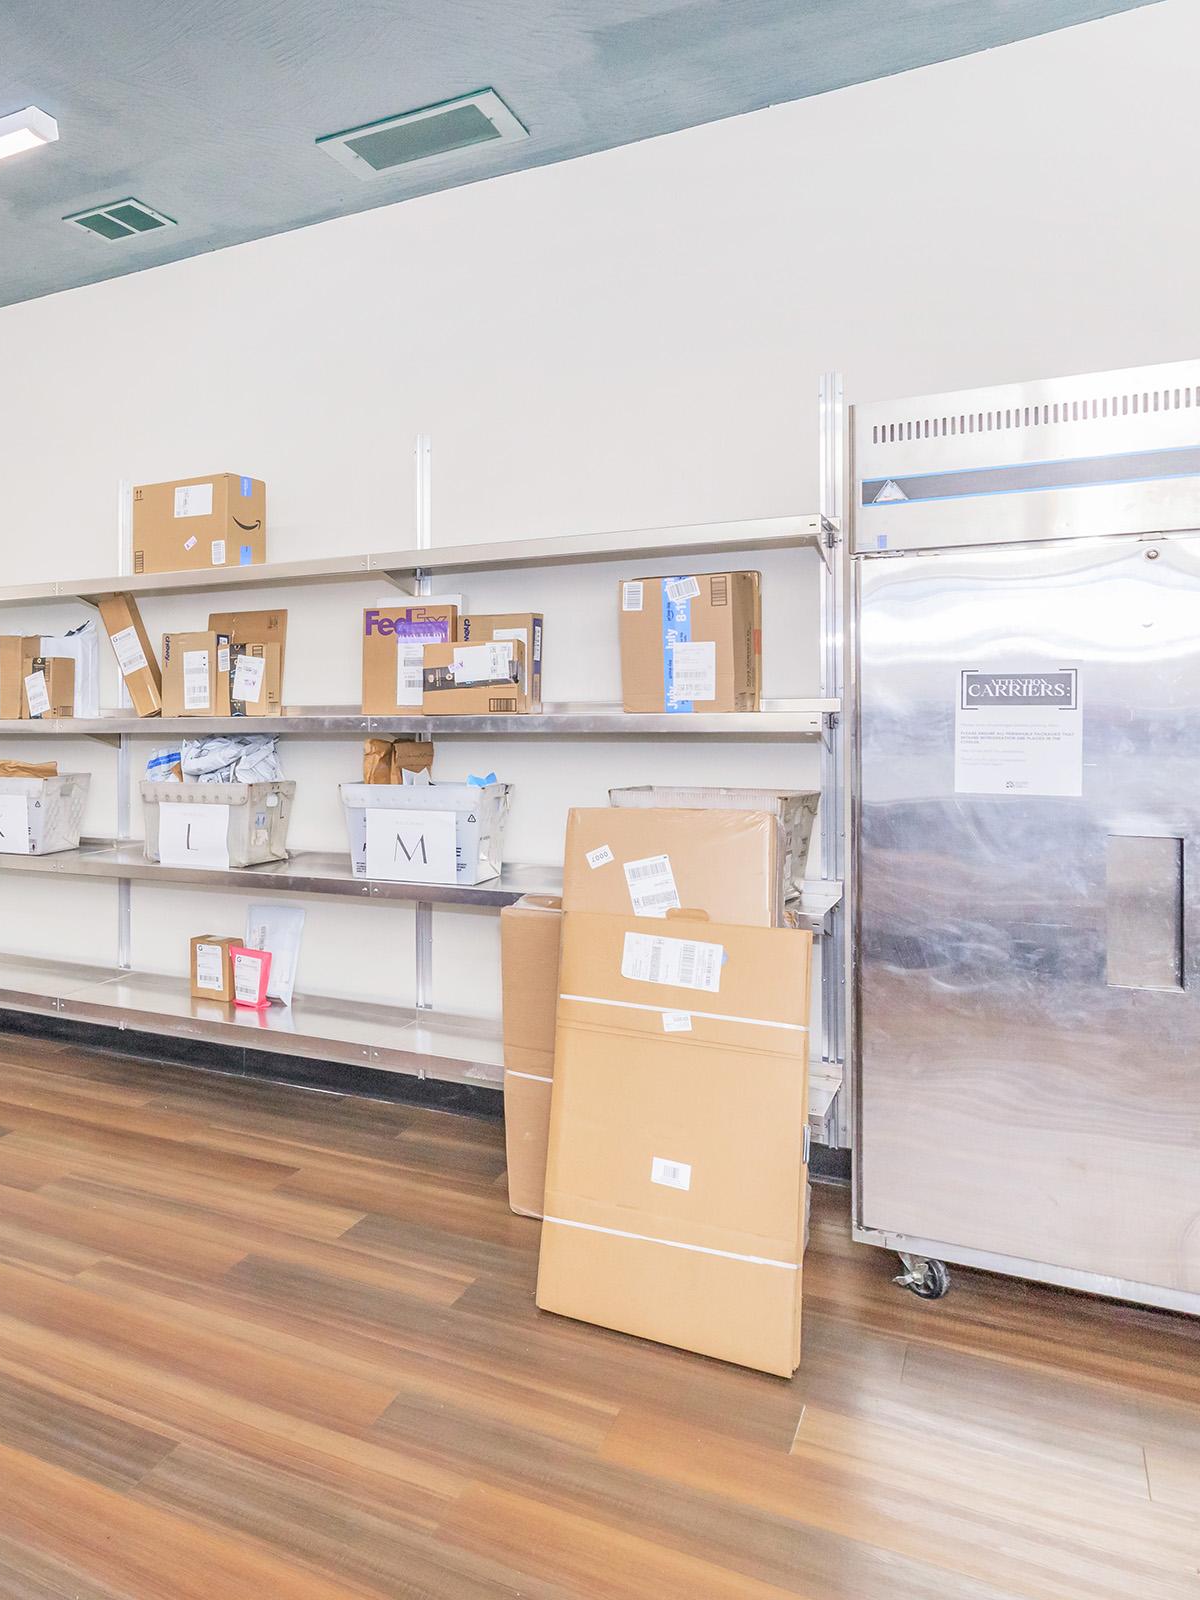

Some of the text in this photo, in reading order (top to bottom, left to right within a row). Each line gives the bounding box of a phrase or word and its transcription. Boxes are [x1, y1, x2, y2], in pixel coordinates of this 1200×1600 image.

[463, 618, 472, 641] chew
[967, 683, 1071, 697] CARRIERS:
[186, 823, 199, 851] L
[393, 832, 428, 864] M
